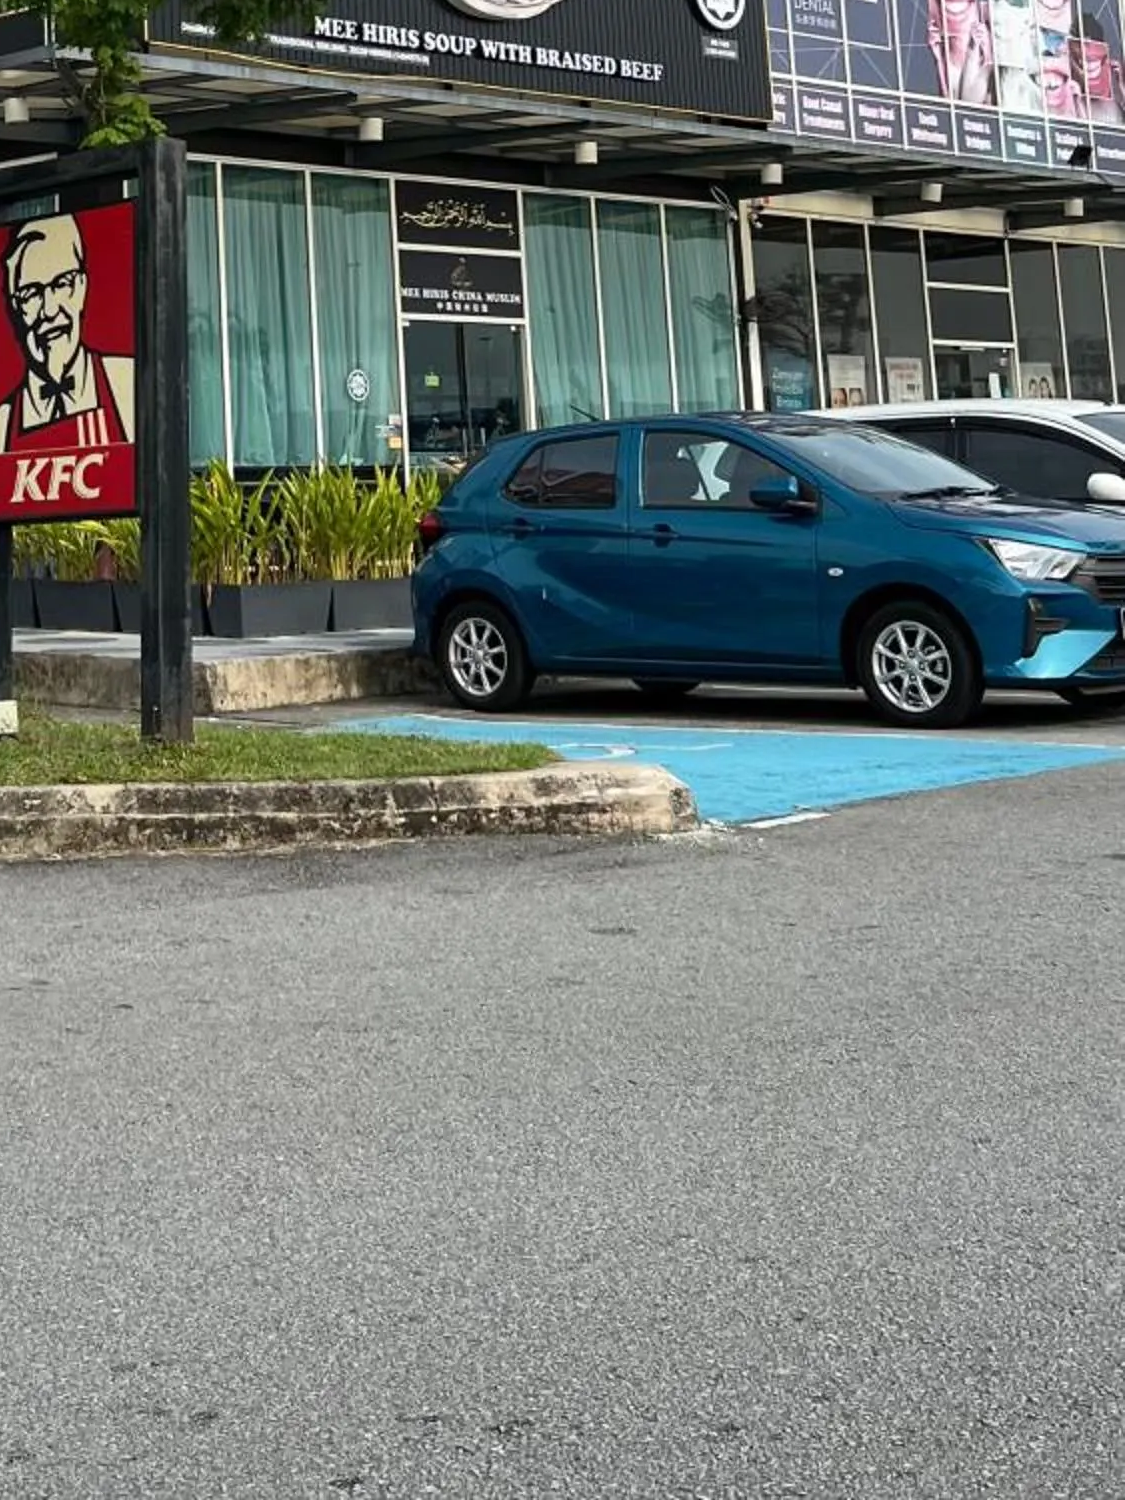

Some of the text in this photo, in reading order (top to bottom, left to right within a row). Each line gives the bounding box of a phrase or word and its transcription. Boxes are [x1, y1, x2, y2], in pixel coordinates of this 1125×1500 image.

[314, 16, 359, 41] MEE
[363, 23, 419, 49] HIRIS
[424, 32, 476, 56] SOUP
[480, 39, 531, 64] WITH
[536, 47, 616, 76] BRAISED
[620, 59, 663, 81] BEEF
[10, 452, 106, 503] KFC
